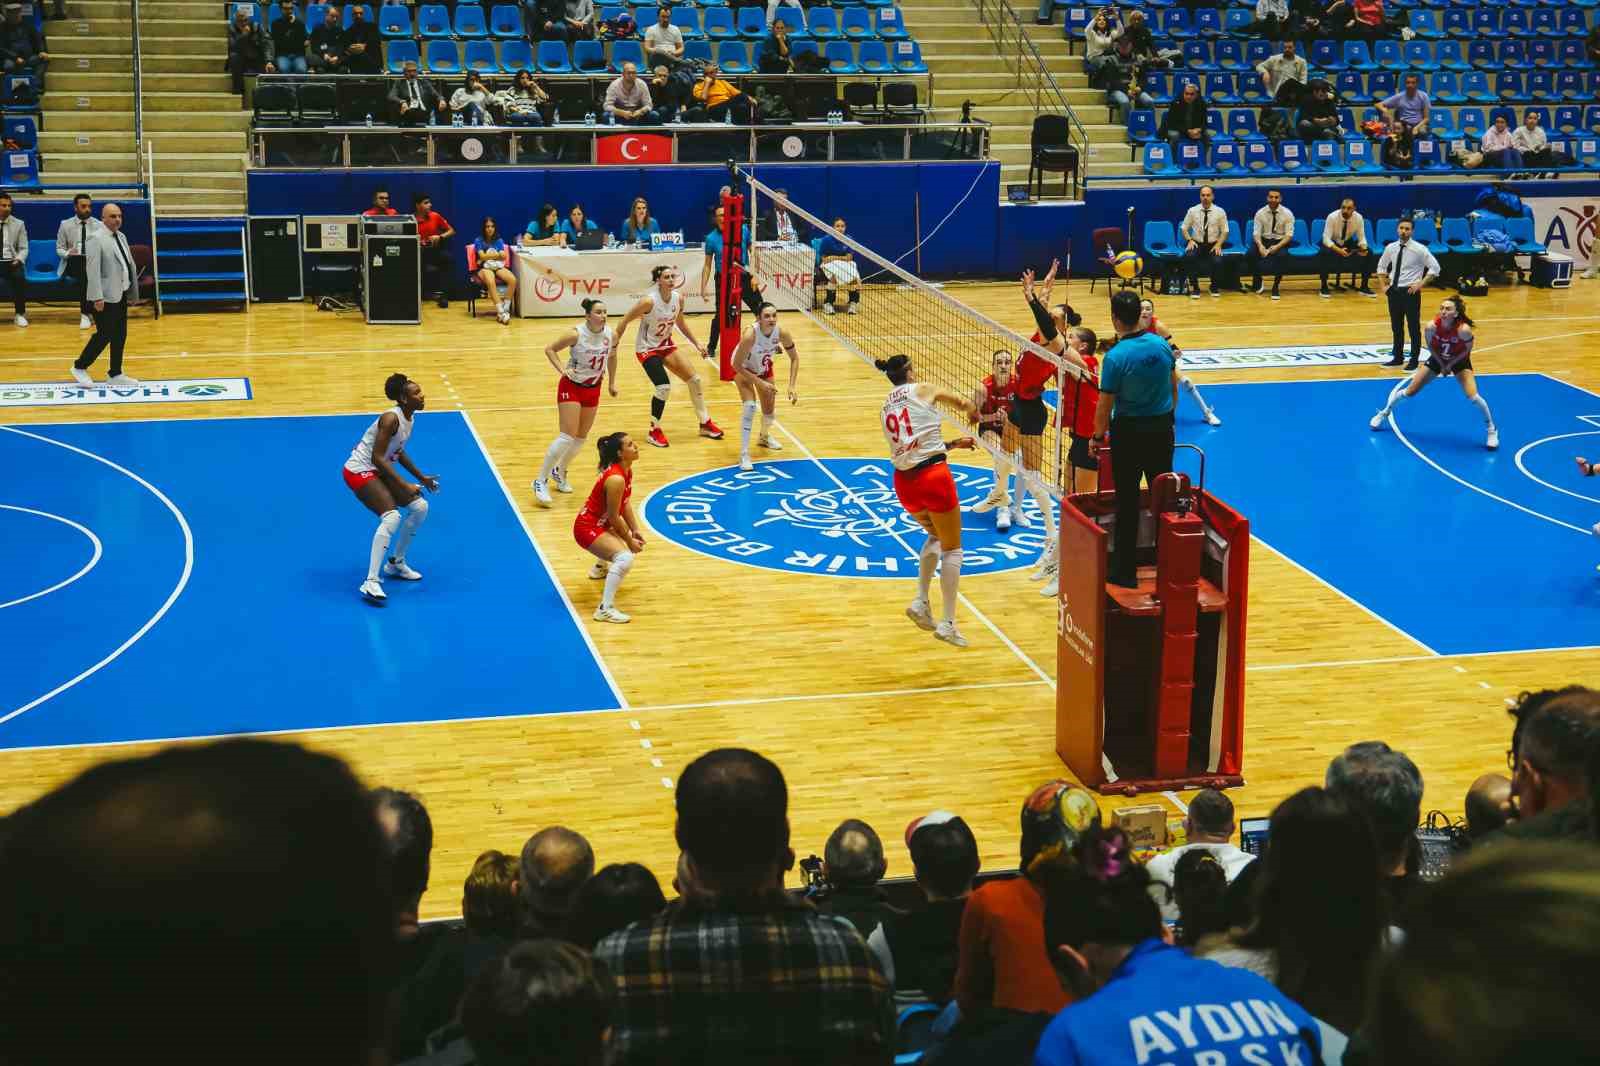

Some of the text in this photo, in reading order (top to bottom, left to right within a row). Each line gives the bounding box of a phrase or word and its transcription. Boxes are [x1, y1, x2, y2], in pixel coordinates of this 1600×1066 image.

[569, 278, 611, 296] TVF
[773, 272, 813, 289] TVF
[655, 319, 675, 337] 27
[588, 355, 605, 371] 11
[885, 407, 913, 443] 91
[664, 465, 794, 556] BELEDİYESİ
[1129, 999, 1299, 1065] AYDIN
